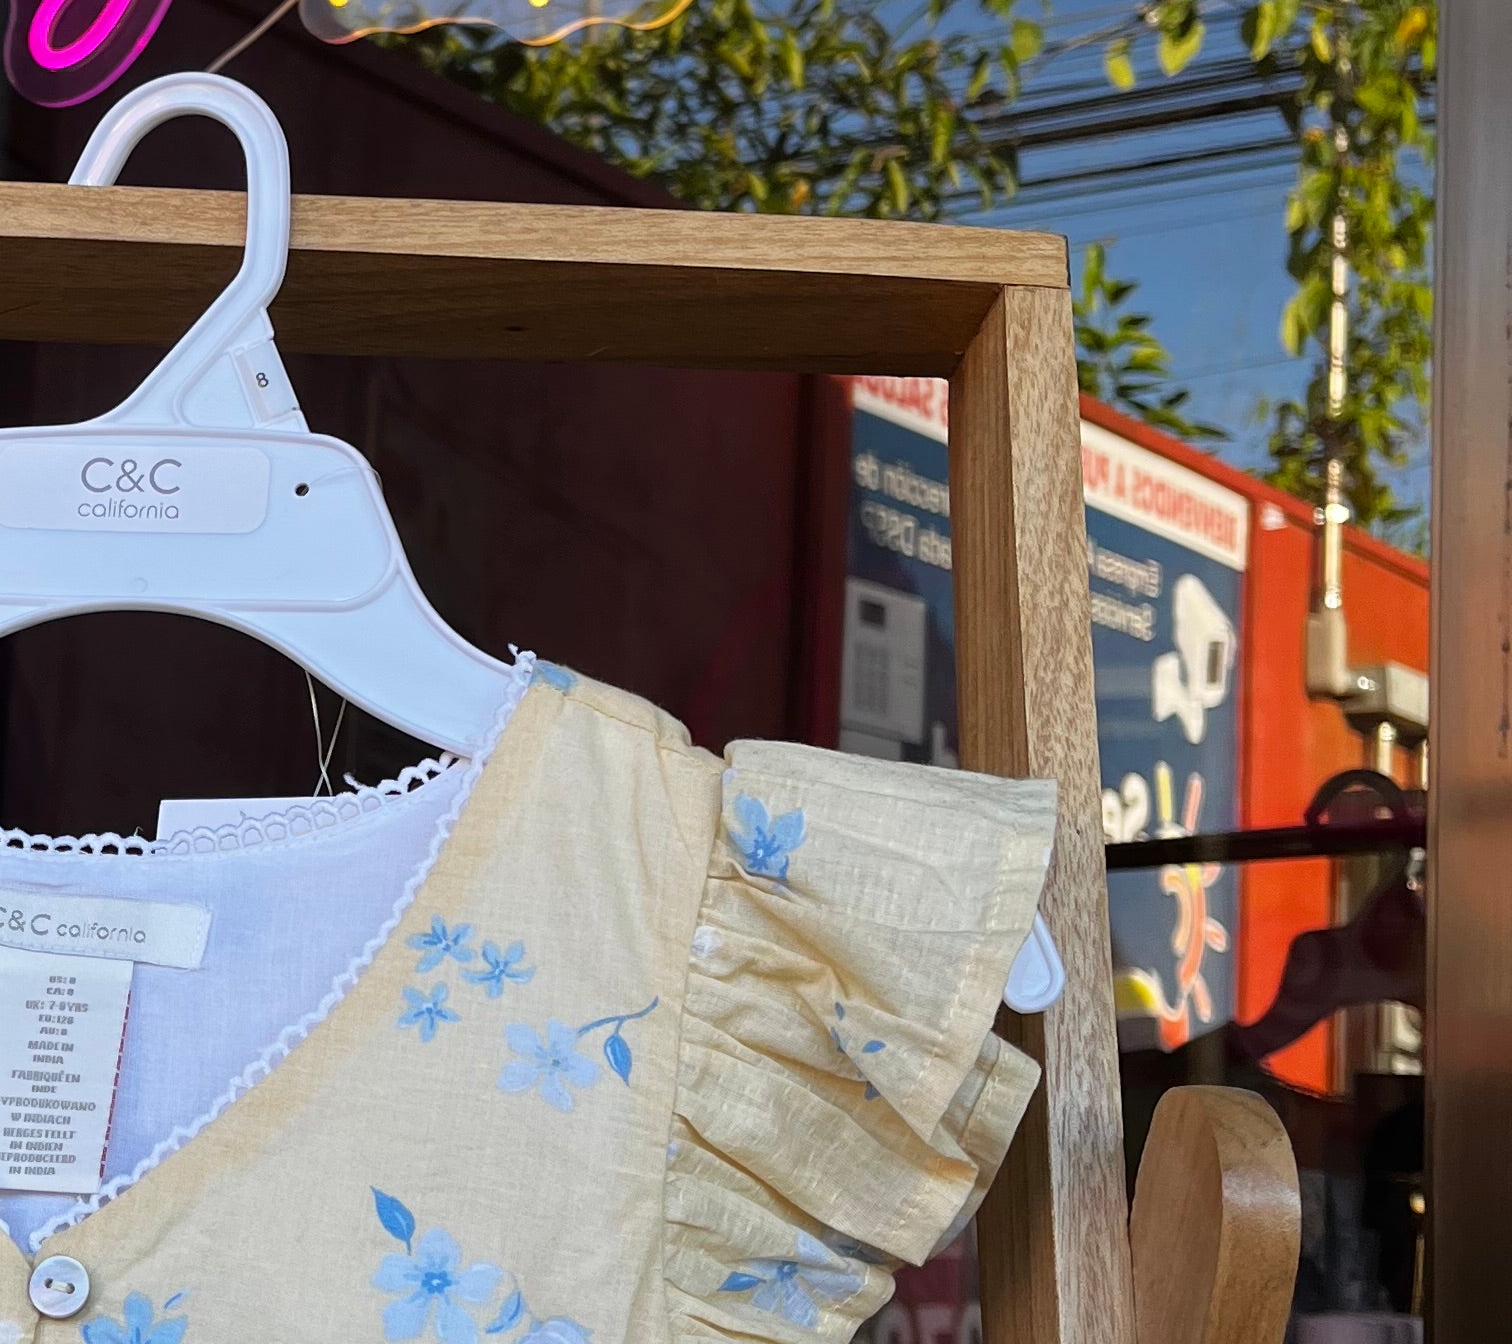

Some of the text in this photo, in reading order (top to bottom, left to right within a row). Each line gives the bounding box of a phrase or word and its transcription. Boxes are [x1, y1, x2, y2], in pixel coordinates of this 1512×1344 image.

[256, 372, 269, 388] 8
[80, 457, 183, 495] C&C
[77, 498, 180, 520] california
[56, 921, 147, 944] california
[27, 1040, 75, 1052] MADE IN
[32, 1054, 65, 1065] INDIA
[8, 1166, 56, 1176] IN INDIA
